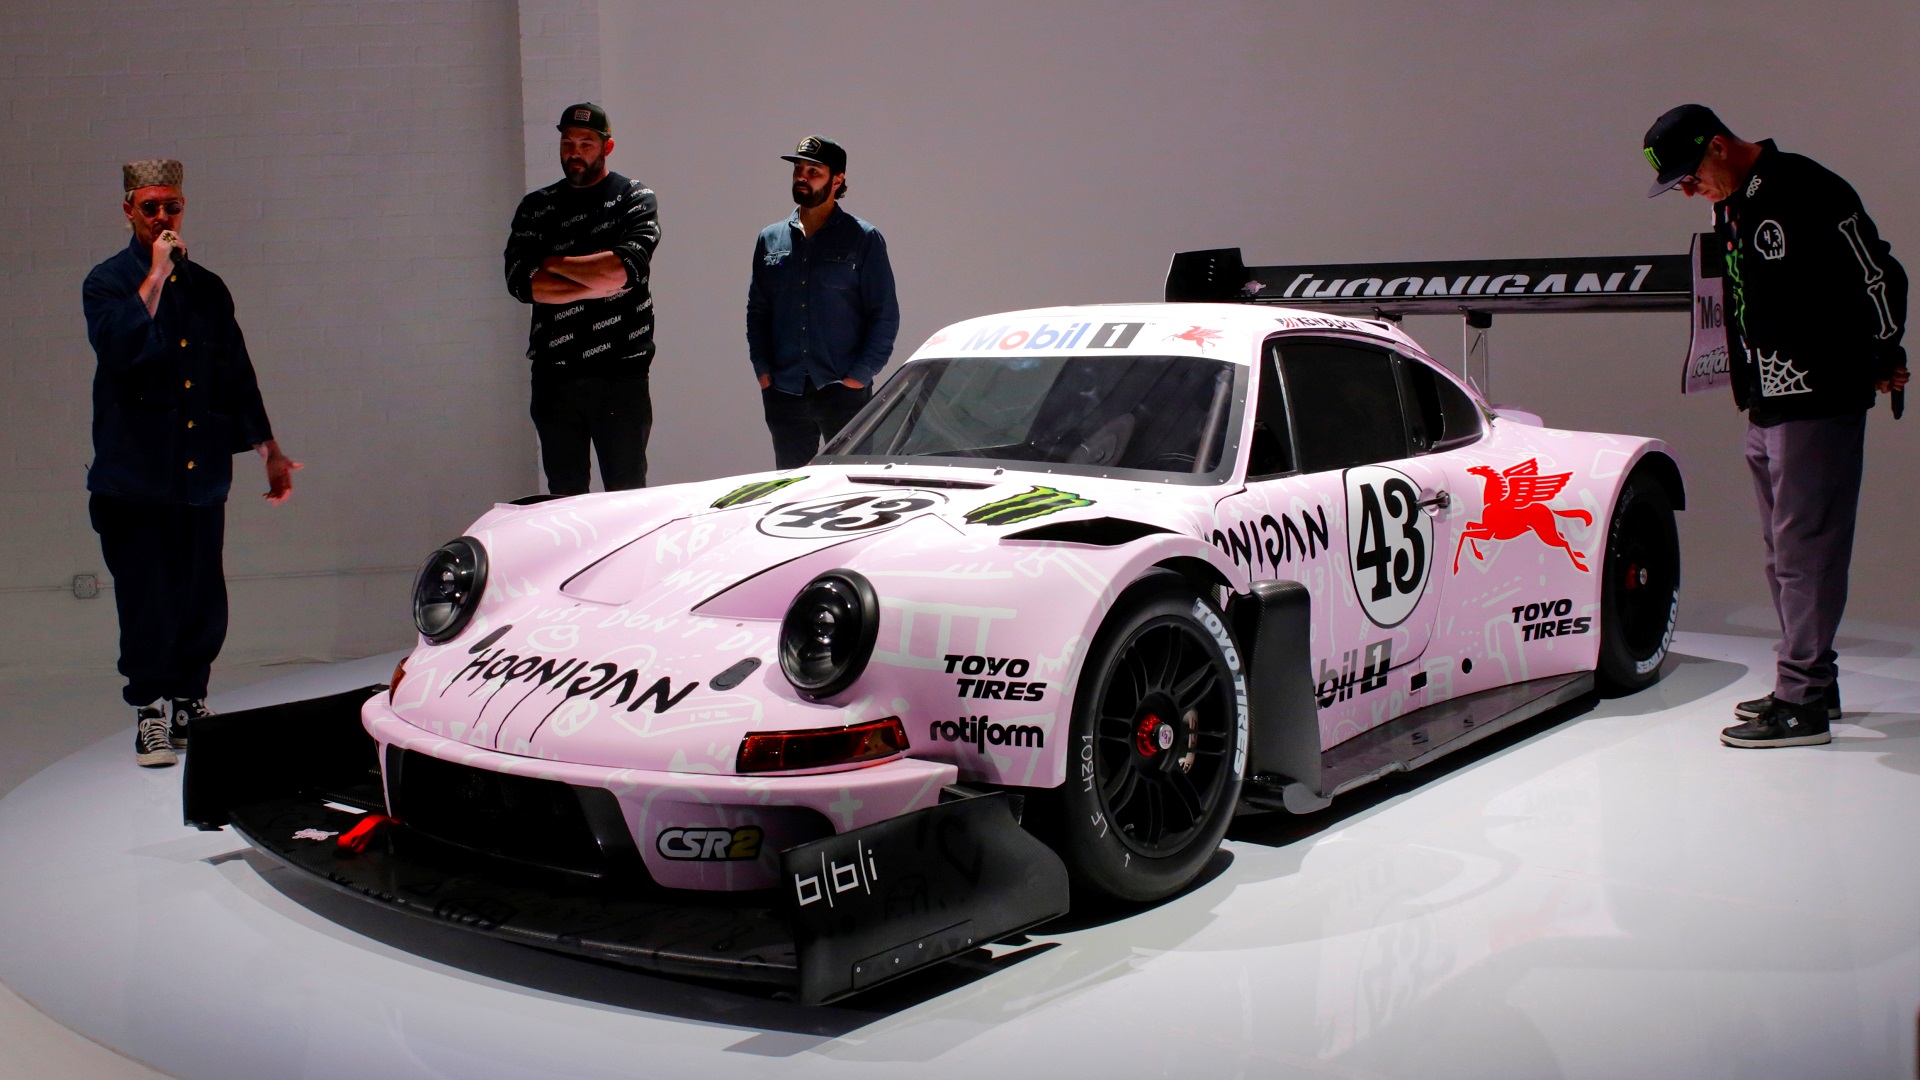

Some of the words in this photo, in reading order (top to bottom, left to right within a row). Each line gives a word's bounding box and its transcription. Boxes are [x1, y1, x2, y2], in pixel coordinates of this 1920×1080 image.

[554, 305, 585, 321] HOONIGAN
[592, 315, 621, 331] HOONIGAN
[549, 333, 574, 348] HOONIGAN
[628, 324, 650, 340] HOONIGAN
[960, 323, 1091, 350] Mobil
[583, 343, 611, 359] HOONIGAN
[774, 496, 936, 531] 43
[1357, 478, 1425, 602] 43
[1512, 598, 1572, 623] TOYO
[1522, 616, 1592, 641] TIRES
[944, 654, 1030, 678] TOYO
[956, 678, 1047, 702] TIRES
[1192, 597, 1240, 671] TOYO
[1233, 673, 1249, 776] TIRES
[930, 715, 1044, 754] rotiform
[1082, 733, 1095, 793] 4301
[658, 827, 763, 859] CSR2
